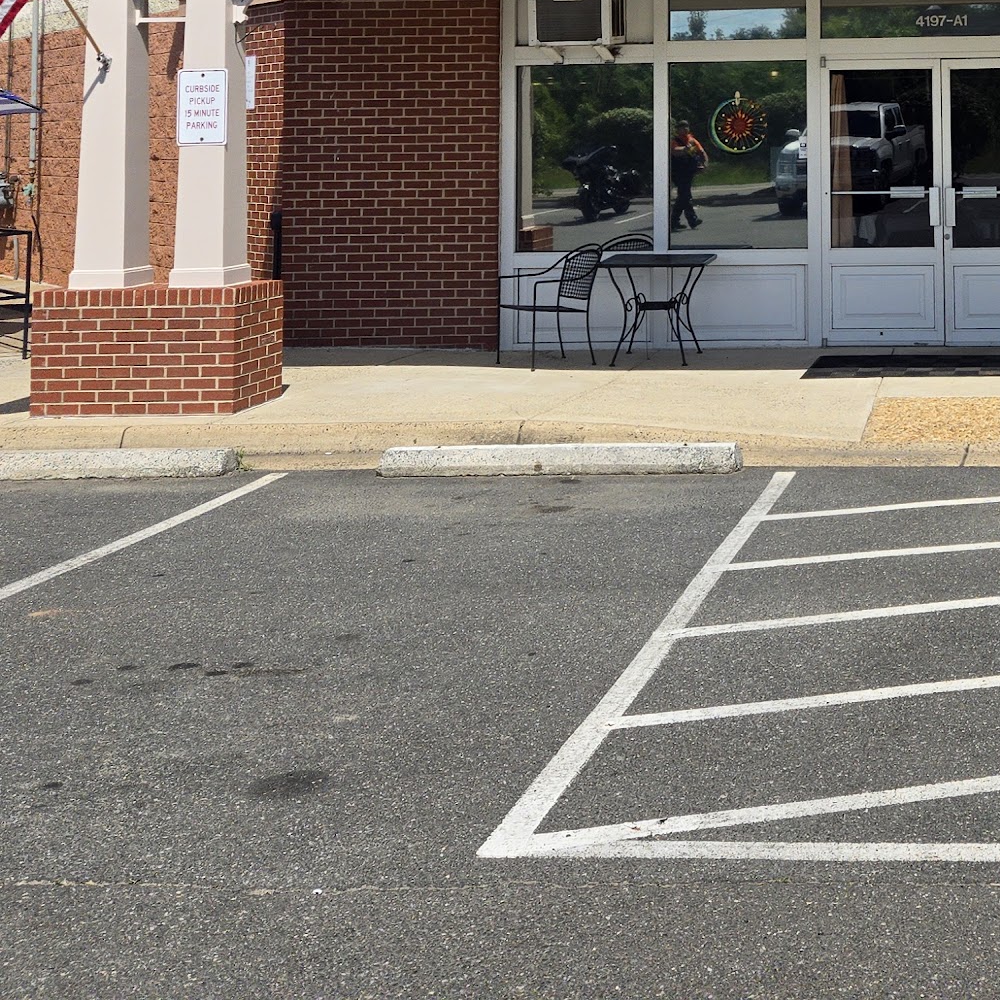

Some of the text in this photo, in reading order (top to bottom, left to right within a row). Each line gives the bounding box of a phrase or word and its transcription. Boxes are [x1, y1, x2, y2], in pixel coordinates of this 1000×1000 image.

[915, 14, 969, 27] 4197-A1
[185, 85, 220, 93] CURBSIDE
[189, 97, 216, 105] PICKUP
[185, 109, 220, 118] 15 MINUTE
[186, 121, 218, 130] PARKING
